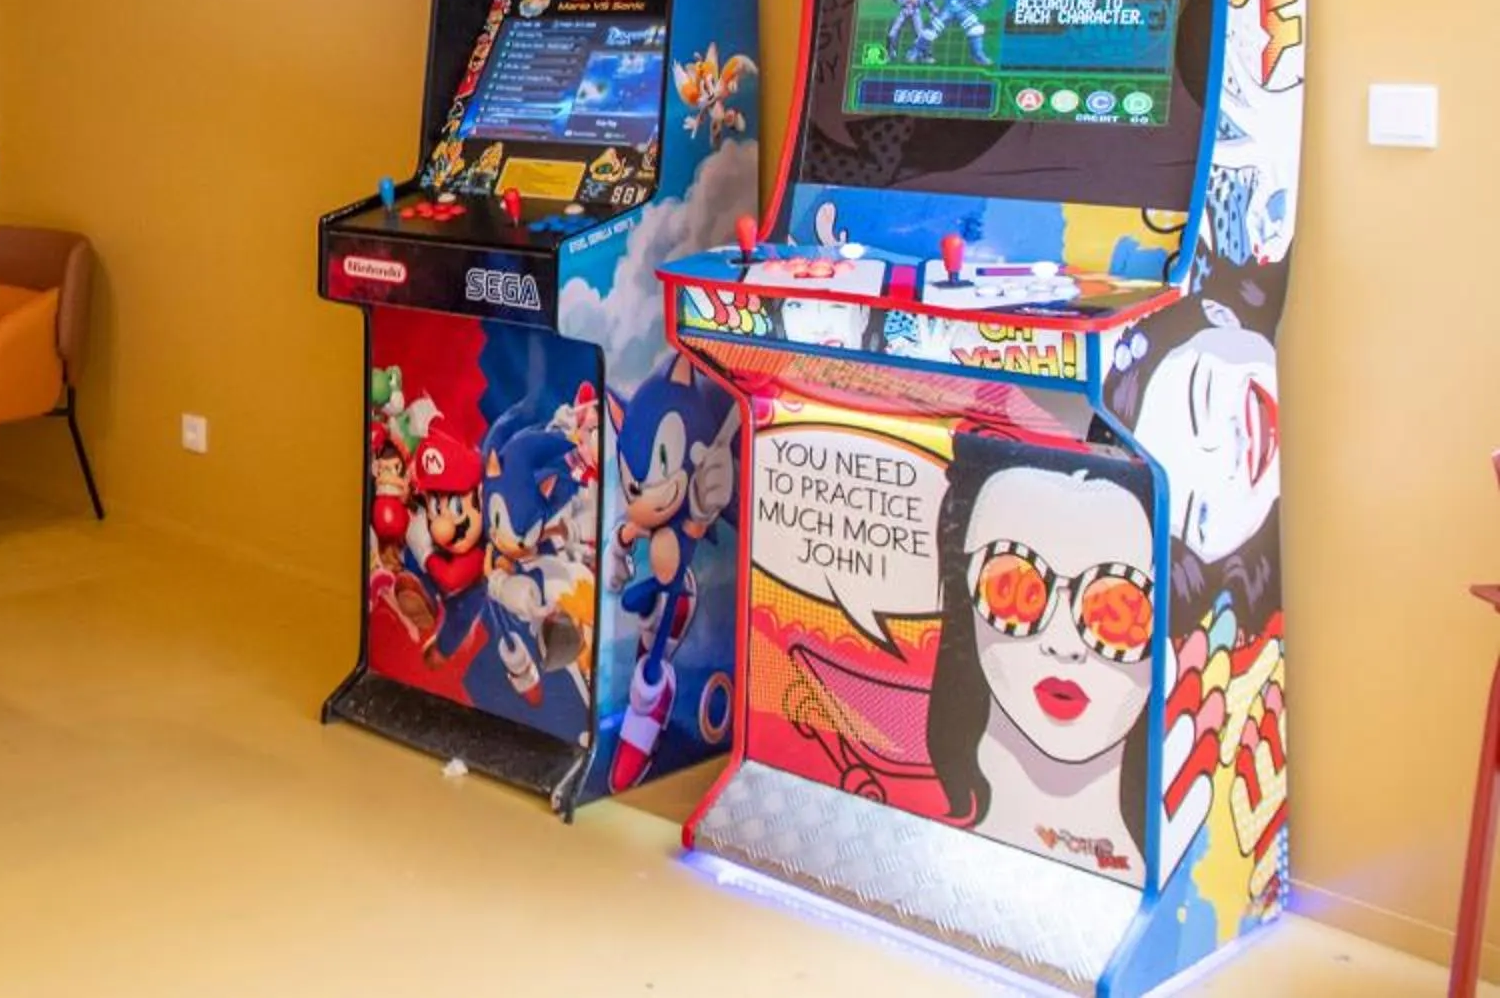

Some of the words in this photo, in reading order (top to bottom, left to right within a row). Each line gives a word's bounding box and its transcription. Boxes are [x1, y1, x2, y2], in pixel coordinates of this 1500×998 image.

[558, 2, 591, 11] Mario
[1013, 9, 1050, 25] EACH
[1057, 9, 1145, 26] CHARACTER.
[347, 260, 402, 280] Nintendo
[465, 267, 541, 311] SEGA
[951, 330, 1078, 380] YEAH!
[771, 438, 828, 471] YOU
[835, 451, 917, 488] NEED
[764, 467, 794, 495] TO
[801, 476, 923, 523] PRACTICE
[759, 497, 834, 537] MUCH
[843, 515, 931, 558] MORE
[797, 537, 873, 577] JOHN
